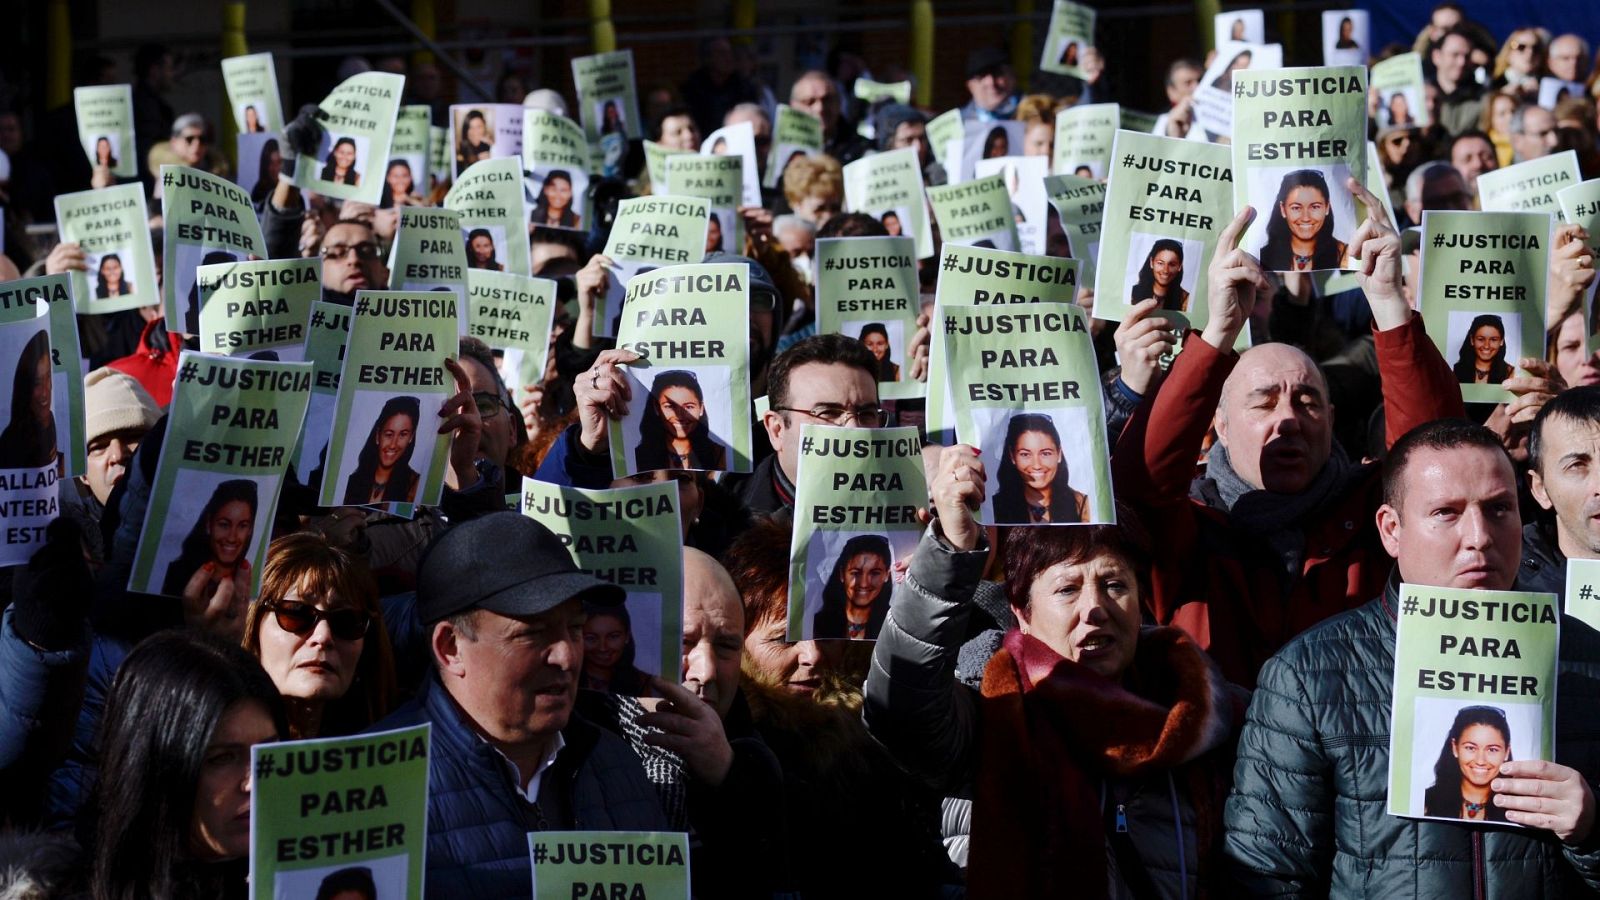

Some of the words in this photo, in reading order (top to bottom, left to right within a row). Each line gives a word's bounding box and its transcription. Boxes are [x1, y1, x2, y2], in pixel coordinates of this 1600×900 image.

[1234, 76, 1363, 99] #JUSTICIA
[332, 115, 378, 132] STHER
[1263, 109, 1333, 129] PARA
[1248, 139, 1348, 161] ESTHER
[1122, 153, 1233, 182] #JUSTICIA
[162, 172, 254, 210] #JUSTICIA
[685, 178, 724, 188] PARA
[1146, 182, 1203, 204] PARA
[65, 196, 137, 220] #JUSTICIA
[190, 199, 240, 224] PARA
[458, 208, 507, 218] STHER
[950, 202, 992, 220] PARA
[1128, 204, 1214, 231] ESTHER
[84, 217, 122, 232] PARA
[630, 222, 680, 238] PARA
[1079, 221, 1102, 235] EST
[79, 232, 133, 248] ESTHER
[178, 223, 254, 250] ESTHER
[420, 239, 454, 256] PARA
[1432, 234, 1540, 250] #JUSTICIA
[614, 242, 690, 262] ESTHER
[825, 256, 912, 270] #JUSTICIA
[406, 264, 462, 280] ESTHER
[942, 254, 1077, 286] #JUSTICIA
[1460, 260, 1516, 275] PARA
[200, 266, 319, 293] #JUSTICIA
[848, 278, 896, 290] PARA
[470, 285, 546, 306] JUSTICIA
[1444, 284, 1527, 301] ESTHER
[226, 298, 290, 318] PARA
[356, 296, 458, 318] #JUSTICIA
[479, 306, 522, 322] PARA
[836, 298, 908, 312] ESTHER
[636, 308, 707, 328] PARA
[944, 312, 1088, 335] #JUSTICIA
[214, 324, 303, 349] ESTHER
[380, 332, 436, 352] PARA
[621, 340, 726, 360] STHER
[981, 347, 1059, 369] PARA
[179, 360, 312, 393] #JUSTICIA
[358, 364, 444, 386] ESTHER
[968, 380, 1081, 402] ESTHER
[210, 405, 280, 430] PARA
[182, 440, 286, 468] ESTHER
[802, 436, 922, 459] #JUSTICIA
[832, 472, 904, 492] PARA
[524, 491, 674, 521] #JUSTICIA
[812, 504, 917, 524] ESTHER
[6, 526, 50, 545] EST
[1402, 596, 1557, 624] #JUSTICIA
[1440, 634, 1522, 659] PARA
[1418, 669, 1538, 696] ESTHER
[256, 736, 428, 779] #JUSTICIA
[300, 785, 388, 818] PARA
[276, 823, 406, 863] ESTHER
[532, 842, 686, 866] #JUSTICIA
